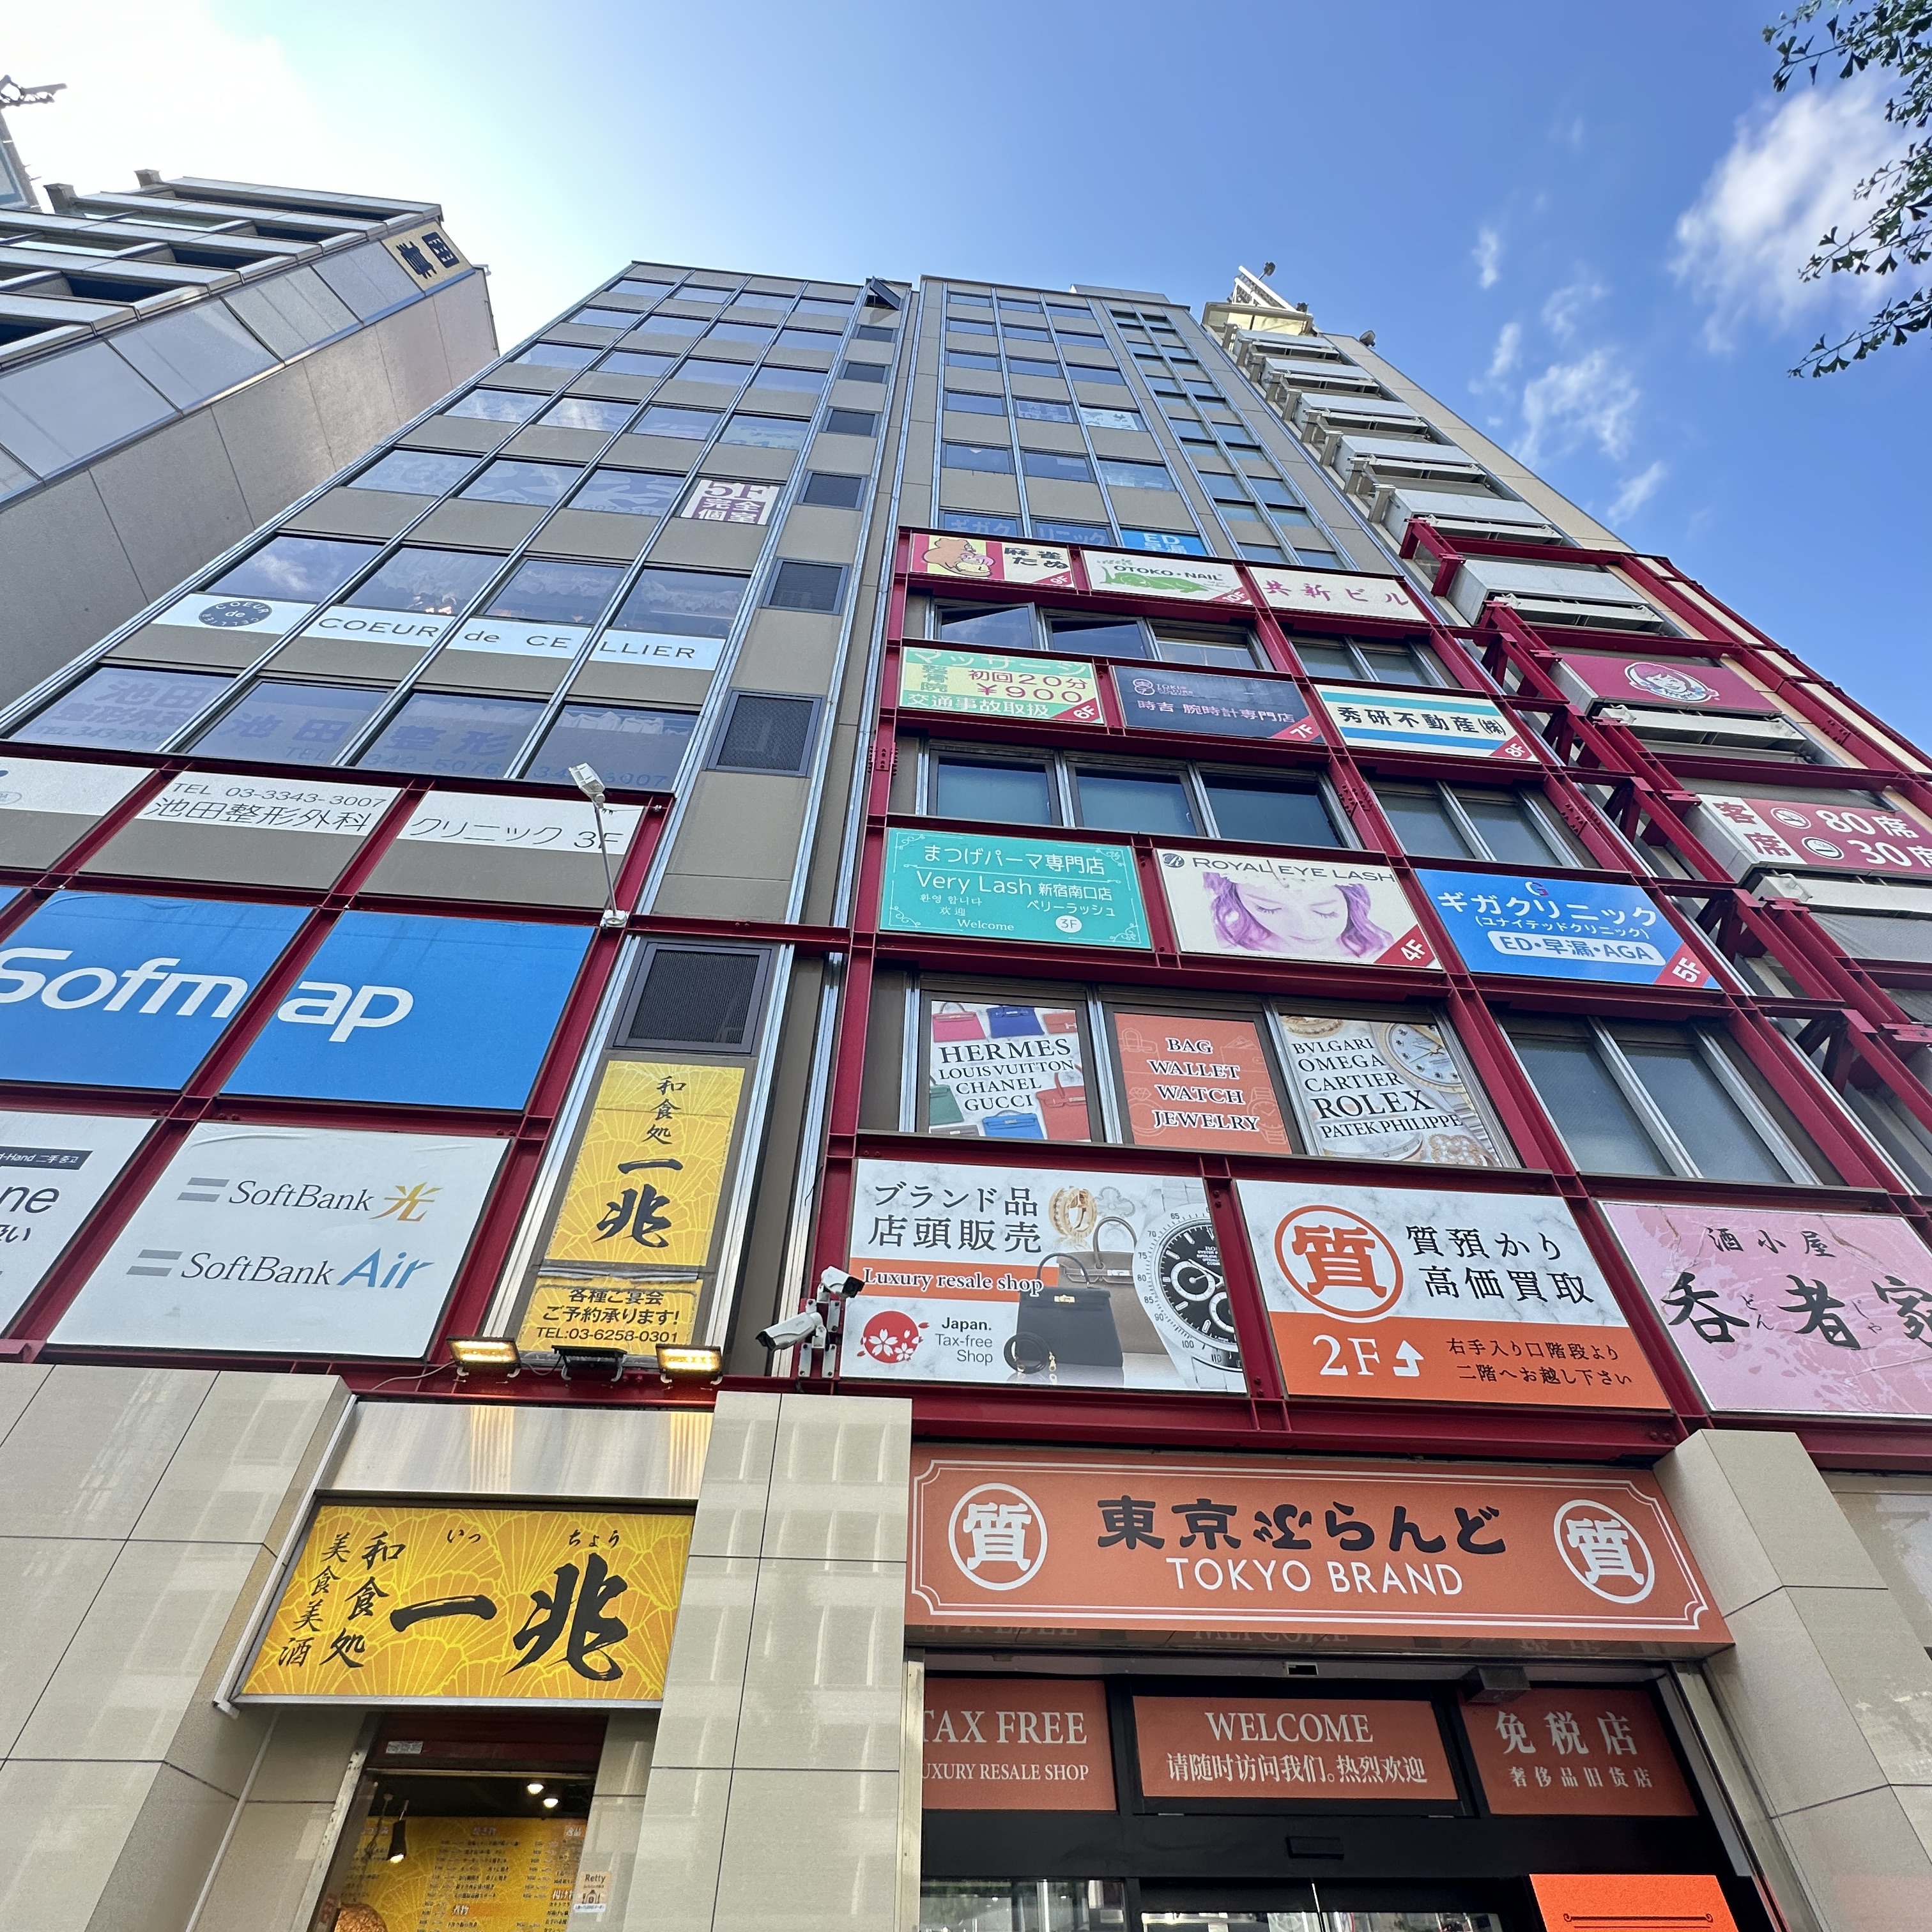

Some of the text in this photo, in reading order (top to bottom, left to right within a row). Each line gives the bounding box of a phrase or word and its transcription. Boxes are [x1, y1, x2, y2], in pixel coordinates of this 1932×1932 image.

[704, 480, 771, 500] 5F
[702, 497, 762, 510] 完全
[697, 509, 756, 523] 個室
[1143, 533, 1180, 544] ED
[1004, 547, 1063, 560] 麻雀
[1012, 556, 1070, 569] たぬ
[1050, 575, 1069, 585] 9F
[1222, 590, 1246, 603] 10F
[1262, 579, 1408, 606] 共新ビル
[215, 601, 270, 614] COEUR
[318, 617, 440, 638] COEUR
[464, 629, 500, 643] de
[914, 648, 1086, 676] マッサージ
[969, 670, 1088, 689] 初回20分
[95, 679, 212, 709] 池田
[977, 683, 1083, 703] ¥900
[907, 693, 1049, 717] 交通事故取扱
[1073, 705, 1096, 720] 6F
[1137, 700, 1296, 723] 時吉 腕時計専門店
[1290, 723, 1314, 741] 7F
[285, 746, 330, 761] TEL
[1504, 742, 1528, 759] 8F
[171, 782, 387, 808] TEL 03-3343-3007
[143, 796, 369, 832] 池田整形外科
[1815, 809, 1920, 839] 80席
[410, 817, 624, 851] クリニック 3F
[1712, 801, 1791, 857] 客席
[924, 844, 1105, 876] まつげパーマ専門店
[1193, 857, 1396, 882] ROYAL EYE LASH
[916, 870, 1112, 901] Very Lash 新宿南口店
[919, 894, 983, 907] 환영 합니다
[1027, 901, 1117, 917] ベリーラッシュ
[1438, 891, 1658, 928] ギガクリニック
[956, 918, 1015, 931] Welcome
[1060, 919, 1078, 929] 3F
[1400, 939, 1426, 963] 4F
[1671, 957, 1702, 984] 5F
[0, 947, 414, 1043] Sofmap
[939, 1038, 1071, 1064] HERMES
[1166, 1038, 1213, 1054] BAG
[1292, 1038, 1376, 1054] BVLGARI
[939, 1059, 1075, 1080] LOUIS VUITTON
[1148, 1059, 1240, 1079] WALLET
[1298, 1054, 1388, 1072] OMEGA
[956, 1078, 1042, 1095] CHANEL
[1304, 1072, 1404, 1092] CARTIER
[965, 1094, 1033, 1112] GUCCI
[1156, 1085, 1245, 1104] WATCH
[1310, 1090, 1435, 1119] ROLEX
[641, 1075, 687, 1145] 和食処
[1153, 1111, 1259, 1131] JEWELRY
[1319, 1114, 1464, 1138] PATEK PHILIPPE
[229, 1180, 443, 1222] SoftBank 光
[593, 1158, 684, 1248] 一兆
[874, 1181, 1038, 1216] ブランド品
[868, 1214, 1043, 1254] 店頭販売
[1147, 1230, 1157, 1238] 70
[1405, 1225, 1563, 1261] 質預かり
[1706, 1227, 1836, 1258] 酒小屋
[181, 1248, 434, 1289] SoftBank Air
[1291, 1225, 1388, 1298] 質
[864, 1268, 1045, 1297] Luxury resale shop
[1418, 1264, 1595, 1305] 高価買取
[569, 1289, 664, 1305] 各種ご宴会
[536, 1327, 678, 1343] TEL:03-6258-0301
[941, 1317, 992, 1334] Japan.
[935, 1333, 993, 1349] Tax-free
[1182, 1340, 1195, 1349] 100
[1446, 1338, 1620, 1361] 右手入り口階段より
[957, 1350, 993, 1365] Shop
[1313, 1333, 1381, 1377] 2F
[1457, 1363, 1633, 1386] 二階へお越し下さい
[447, 1528, 482, 1544] いっ
[1097, 1495, 1506, 1555] 東京ぶらんど
[569, 1531, 621, 1549] ちょう
[963, 1502, 1032, 1572] 質
[1565, 1517, 1645, 1586] 質
[1166, 1558, 1463, 1596] TOKYO BRAND
[279, 1533, 351, 1668] 美食美酒
[318, 1531, 406, 1669] 和食処
[389, 1551, 629, 1682] 一兆
[996, 1711, 1087, 1745] FREE
[1205, 1712, 1374, 1743] WELCOME
[1494, 1710, 1639, 1756] 免税店
[923, 1763, 1089, 1781] UXURY RESALE SHOP
[1167, 1752, 1428, 1784] 请随时访问我们。热烈欢迎
[1509, 1766, 1653, 1788] 奢侈品旧货店
[585, 1873, 606, 1883] Retty
